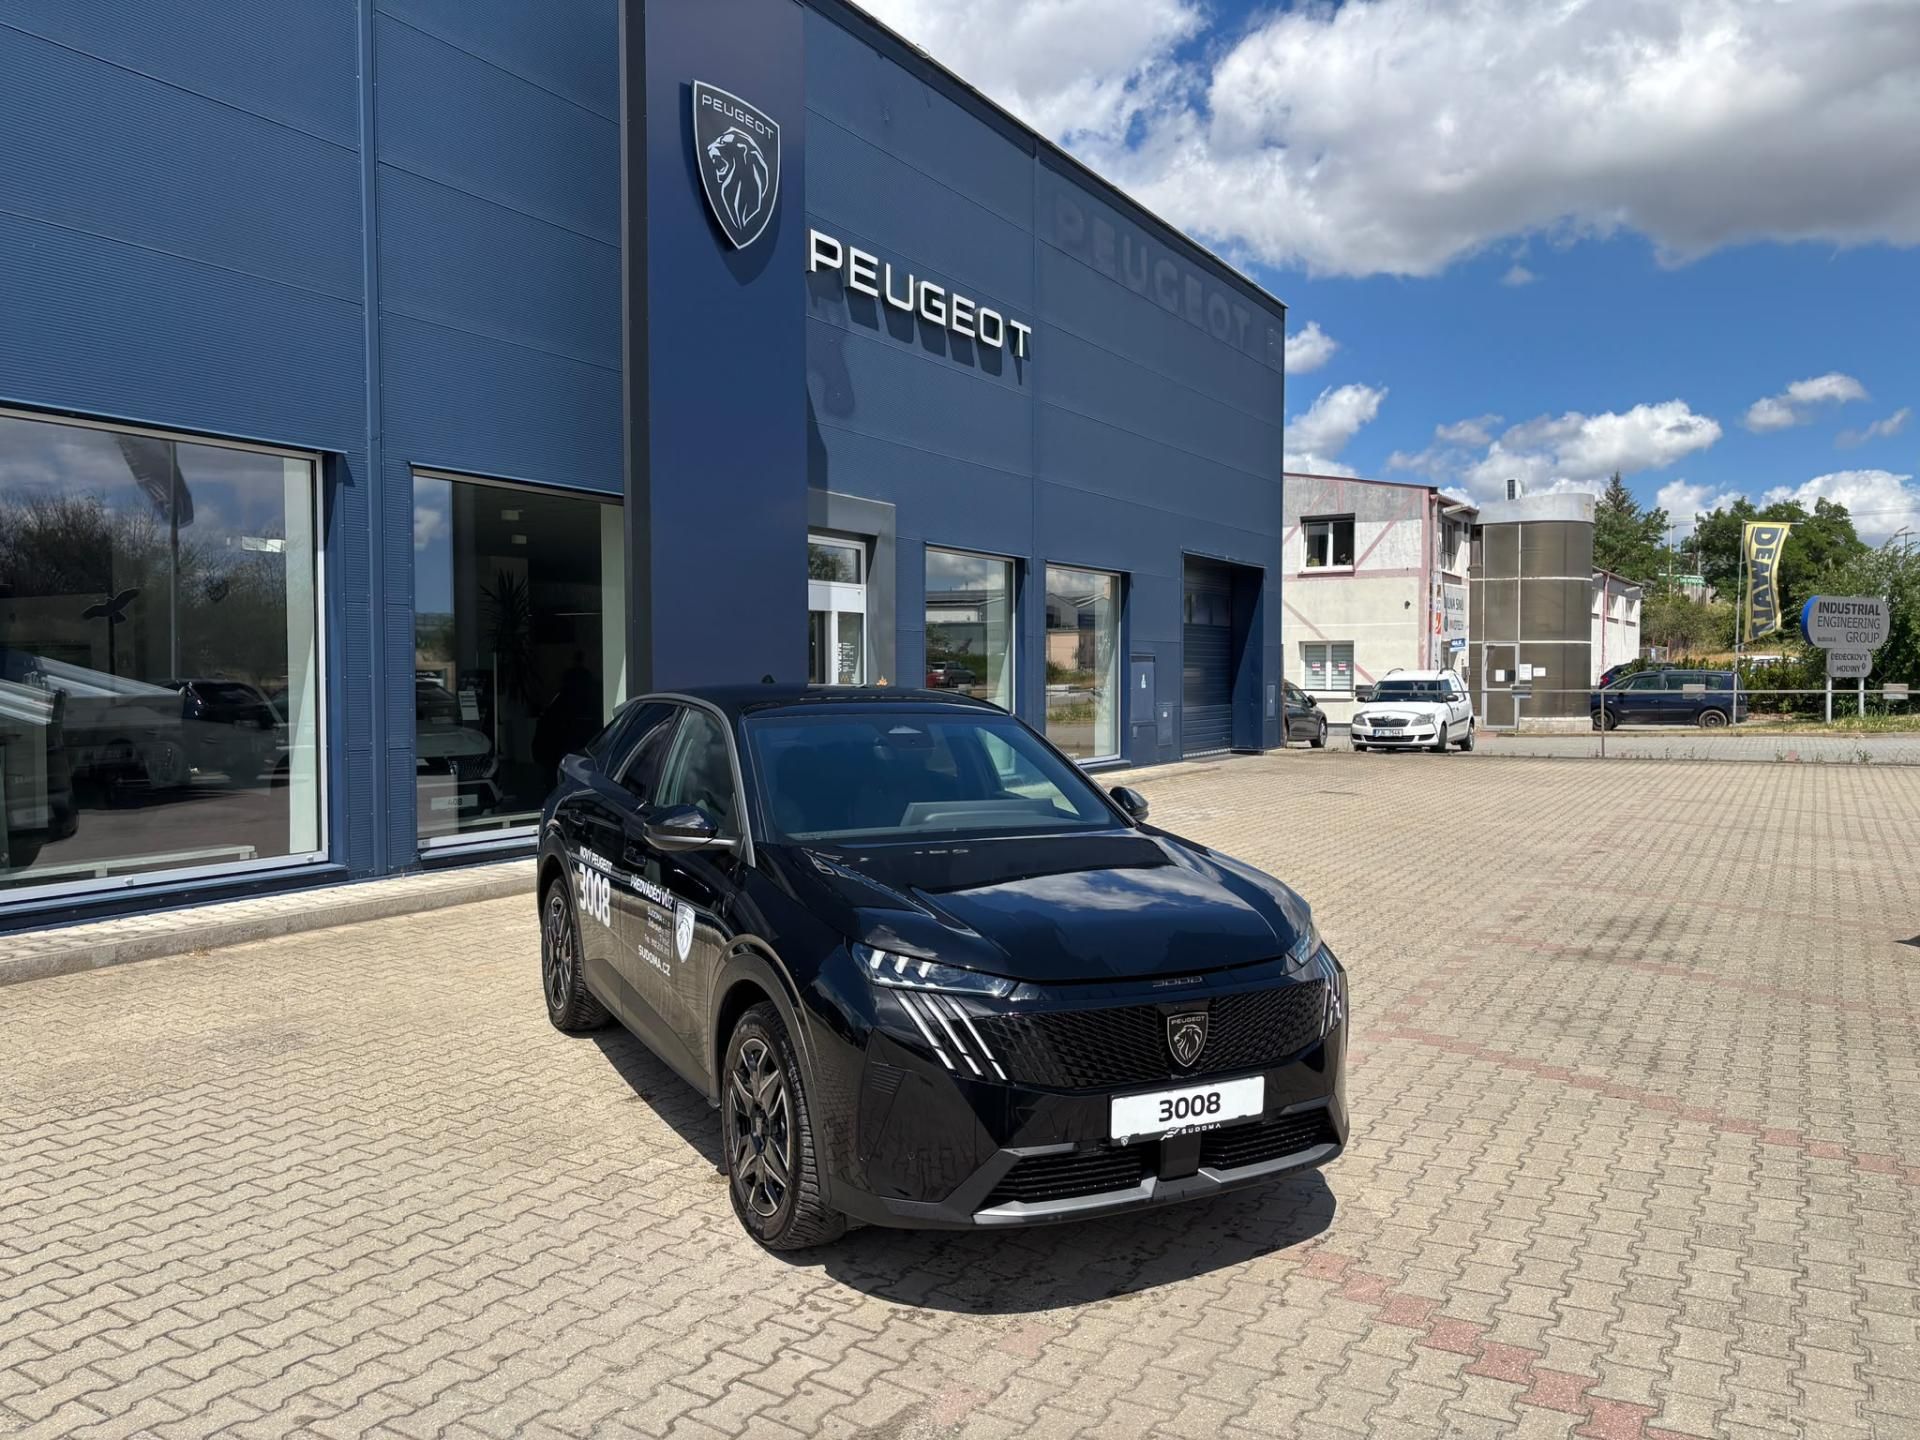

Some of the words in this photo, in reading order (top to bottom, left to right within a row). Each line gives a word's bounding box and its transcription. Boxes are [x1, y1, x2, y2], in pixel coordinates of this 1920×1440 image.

[702, 93, 775, 140] PEUGEOT
[810, 228, 1032, 358] PEUGEOT
[1817, 615, 1880, 630] ENGINEERING
[1818, 602, 1881, 616] INDUSTRIAL
[1845, 631, 1880, 644] GROUP
[580, 845, 592, 861] NOVÝ
[591, 849, 613, 874] PEUGEOT
[579, 862, 611, 928] 3008
[638, 944, 671, 977] SUDOMA.CZ
[1171, 1015, 1206, 1025] PEUGEOT
[1158, 1091, 1221, 1123] 3008
[1181, 1123, 1222, 1135] SUDOMA
